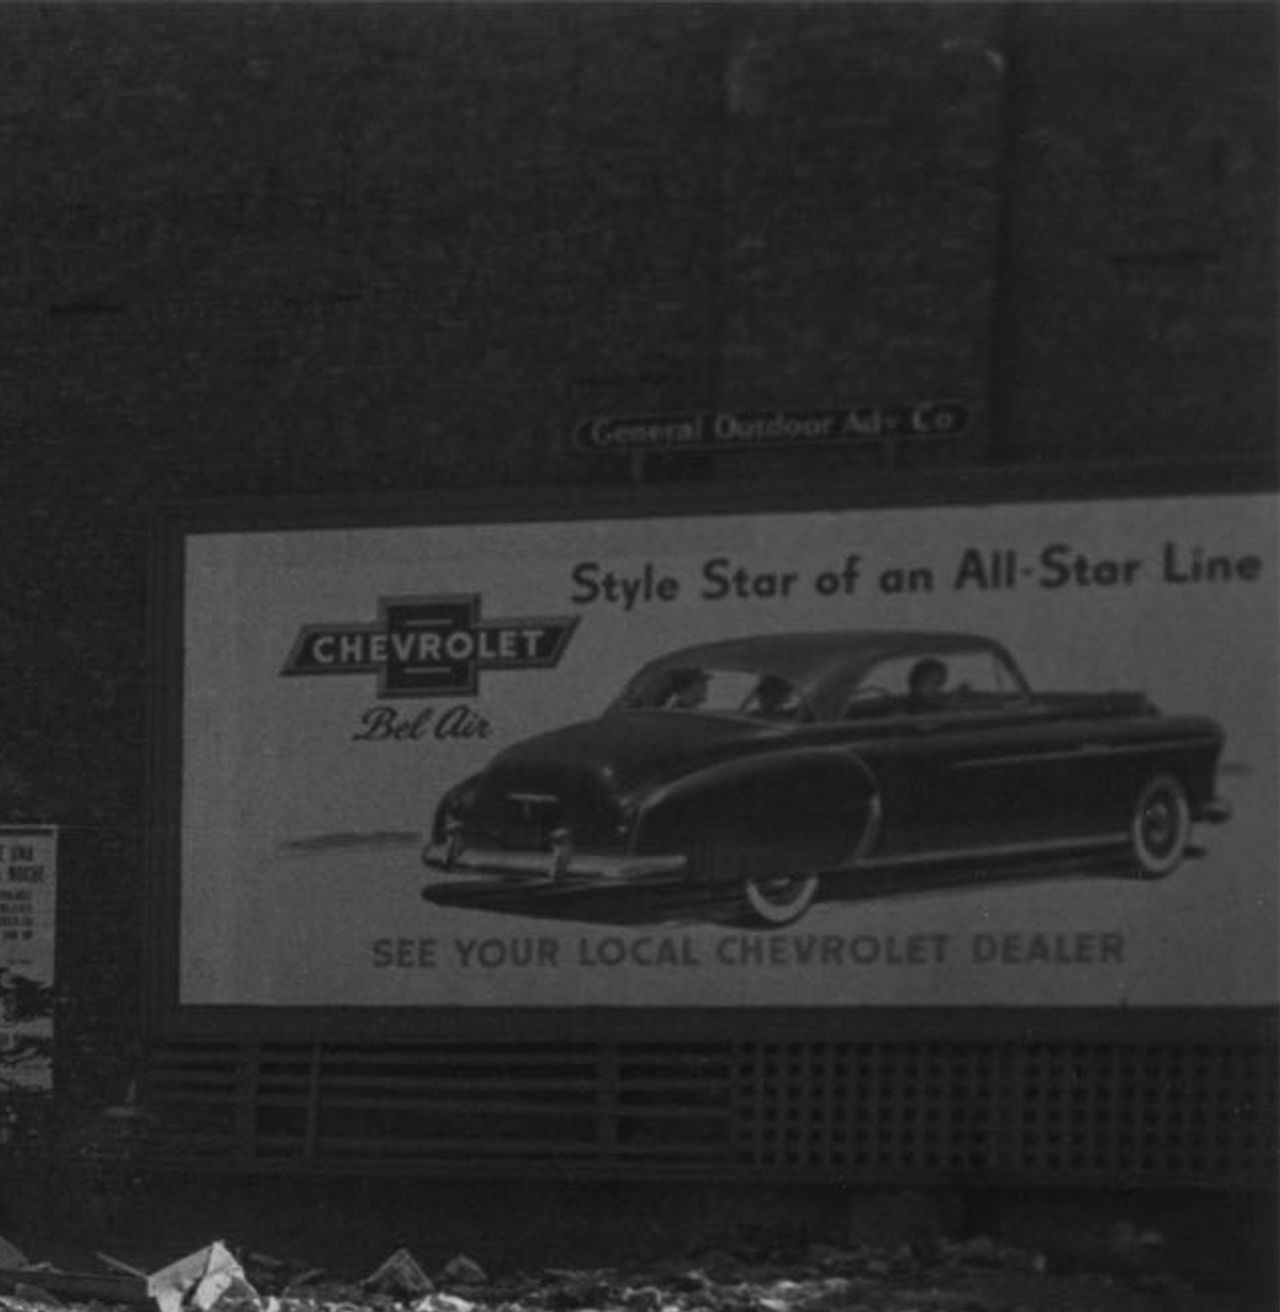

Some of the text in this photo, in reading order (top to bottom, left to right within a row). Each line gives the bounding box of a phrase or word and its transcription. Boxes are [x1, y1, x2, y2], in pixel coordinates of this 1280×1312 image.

[591, 411, 702, 446] General
[715, 409, 834, 439] Outdoor
[572, 541, 1264, 609] Style Star of an All-Star Line
[312, 630, 544, 665] CHEVROLET
[351, 703, 490, 742] Bel Air
[371, 933, 1127, 968] SEE YOUR LOCAL CHEVROLET DEALER
